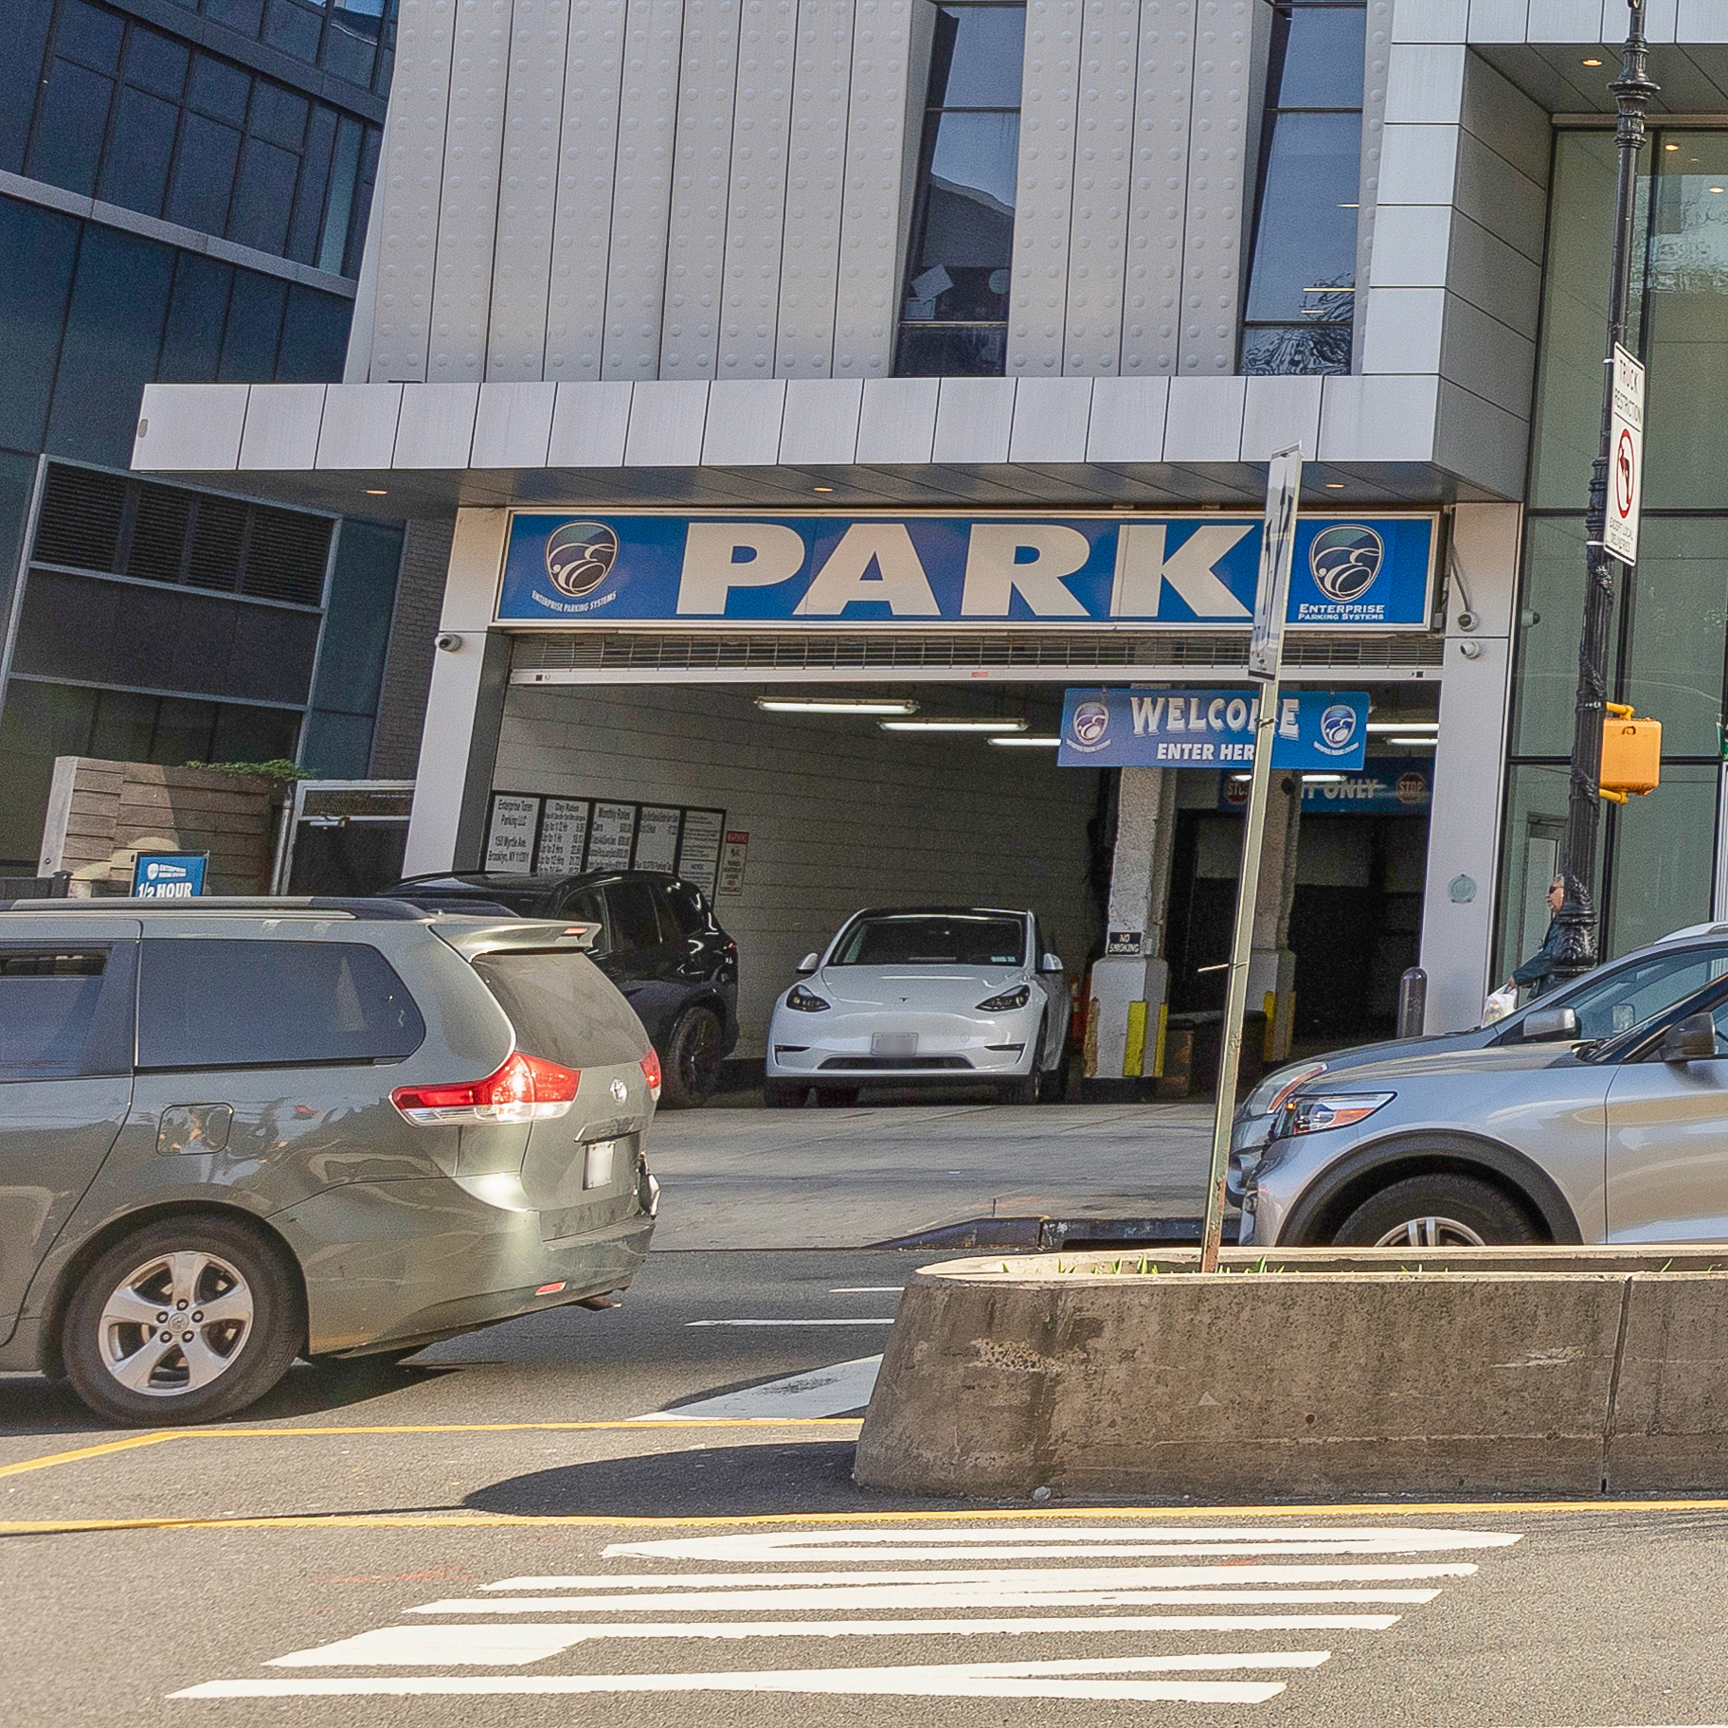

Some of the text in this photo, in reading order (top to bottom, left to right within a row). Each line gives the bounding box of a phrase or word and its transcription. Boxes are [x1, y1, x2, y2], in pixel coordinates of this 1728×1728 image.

[1618, 359, 1640, 395] TRUCK
[1614, 387, 1642, 422] RESTRICTION
[676, 522, 1255, 618] PARK
[531, 589, 617, 612] ENTERPRISE PARKING SYSTEMS
[1299, 603, 1385, 614] ENTERPRISE
[1297, 612, 1384, 621] PARKING SYSTEMS
[1156, 742, 1257, 761] ENTER HER
[1399, 780, 1424, 795] STOP
[155, 882, 193, 898] HOUR
[165, 1526, 1525, 1704] ONLY
